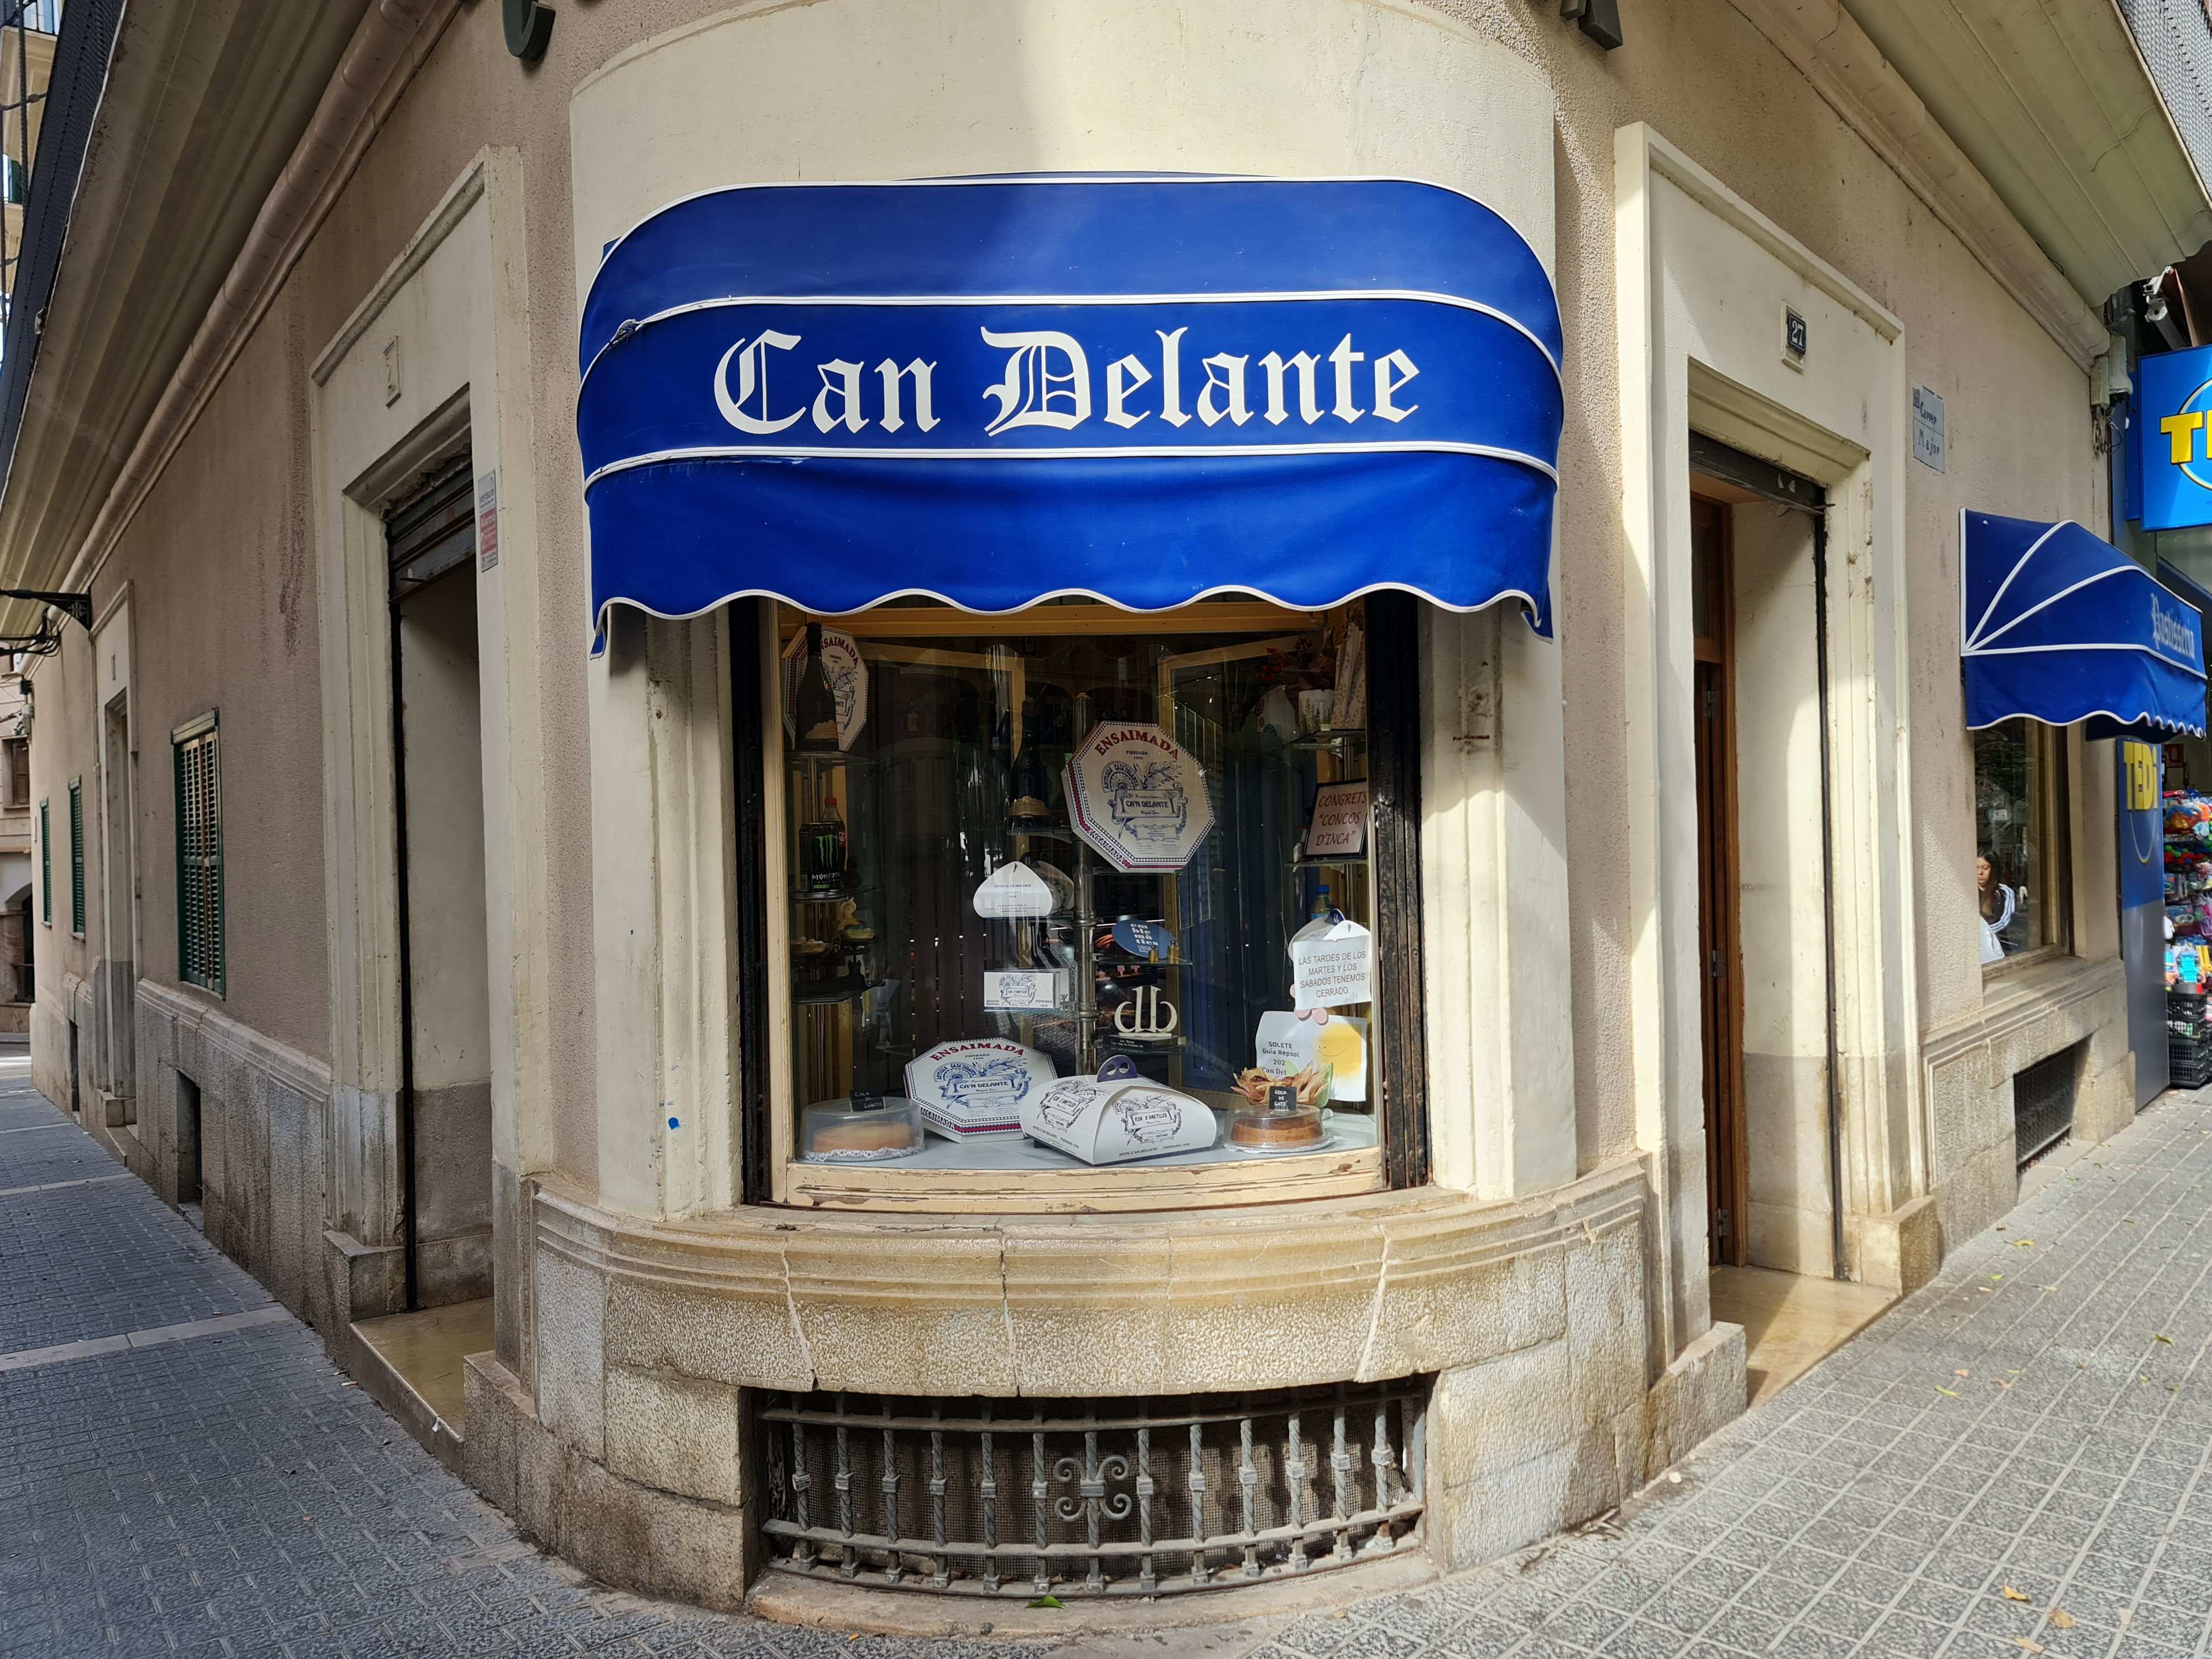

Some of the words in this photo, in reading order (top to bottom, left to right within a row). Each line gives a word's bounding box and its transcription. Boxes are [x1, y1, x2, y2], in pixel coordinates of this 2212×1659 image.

[1792, 320, 1803, 346] 27
[714, 329, 941, 434] Can
[980, 326, 1420, 437] Delante
[1918, 429, 1940, 456] Major
[2159, 409, 2212, 465] T
[1094, 729, 1178, 760] ENSAIMADA
[1318, 791, 1368, 807] CONGRETS
[1298, 956, 1312, 966] LAS
[1313, 953, 1340, 964] TARDES
[1342, 952, 1351, 961] DE
[1353, 951, 1366, 959] LOS
[1308, 965, 1335, 976] MARTES
[1343, 963, 1357, 972] LOS
[1300, 977, 1332, 989] SABADOS
[1333, 973, 1365, 984] TENEMOS
[1316, 986, 1350, 998] CERRADO.
[929, 1042, 1025, 1062] ENSAIMADA
[1278, 1050, 1300, 1058] Repsol
